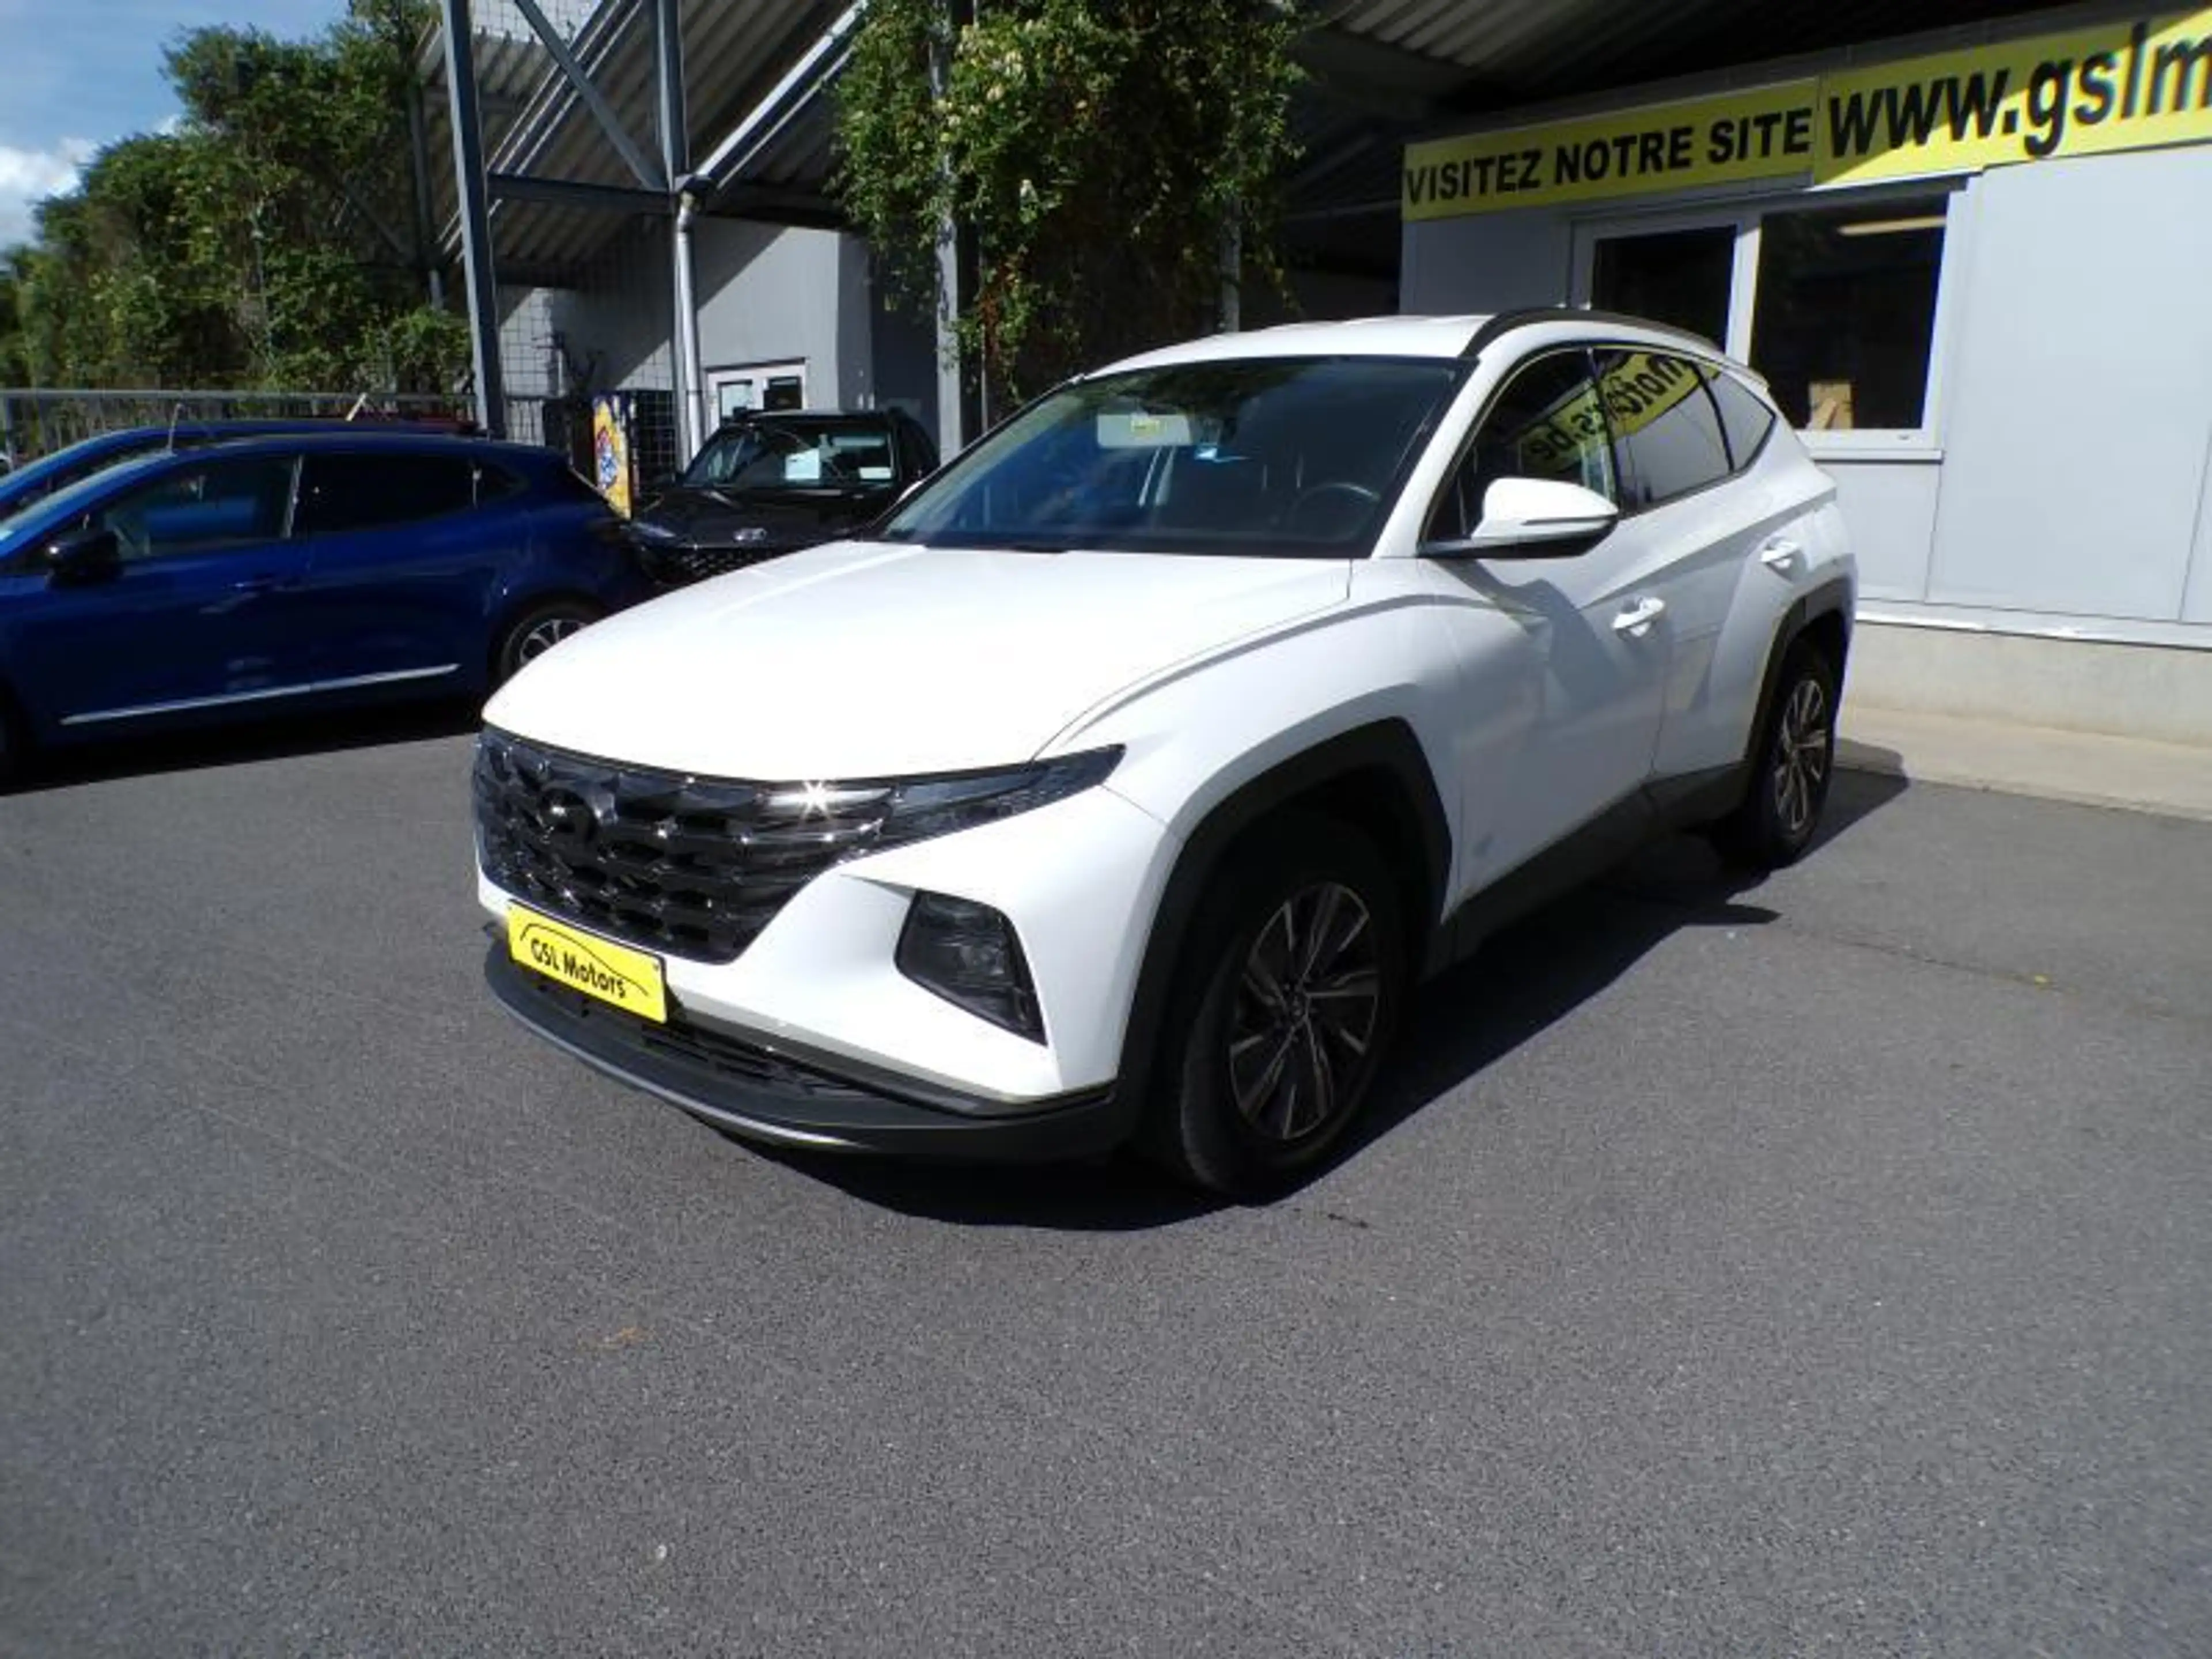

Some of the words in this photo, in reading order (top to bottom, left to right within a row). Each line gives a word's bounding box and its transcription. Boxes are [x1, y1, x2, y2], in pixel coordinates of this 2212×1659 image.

[1406, 149, 1542, 205] VISITEZ
[1555, 127, 1693, 184] NOTRE
[1709, 108, 1813, 164] SITE
[531, 938, 560, 972] GSL
[563, 951, 626, 999] Motors
